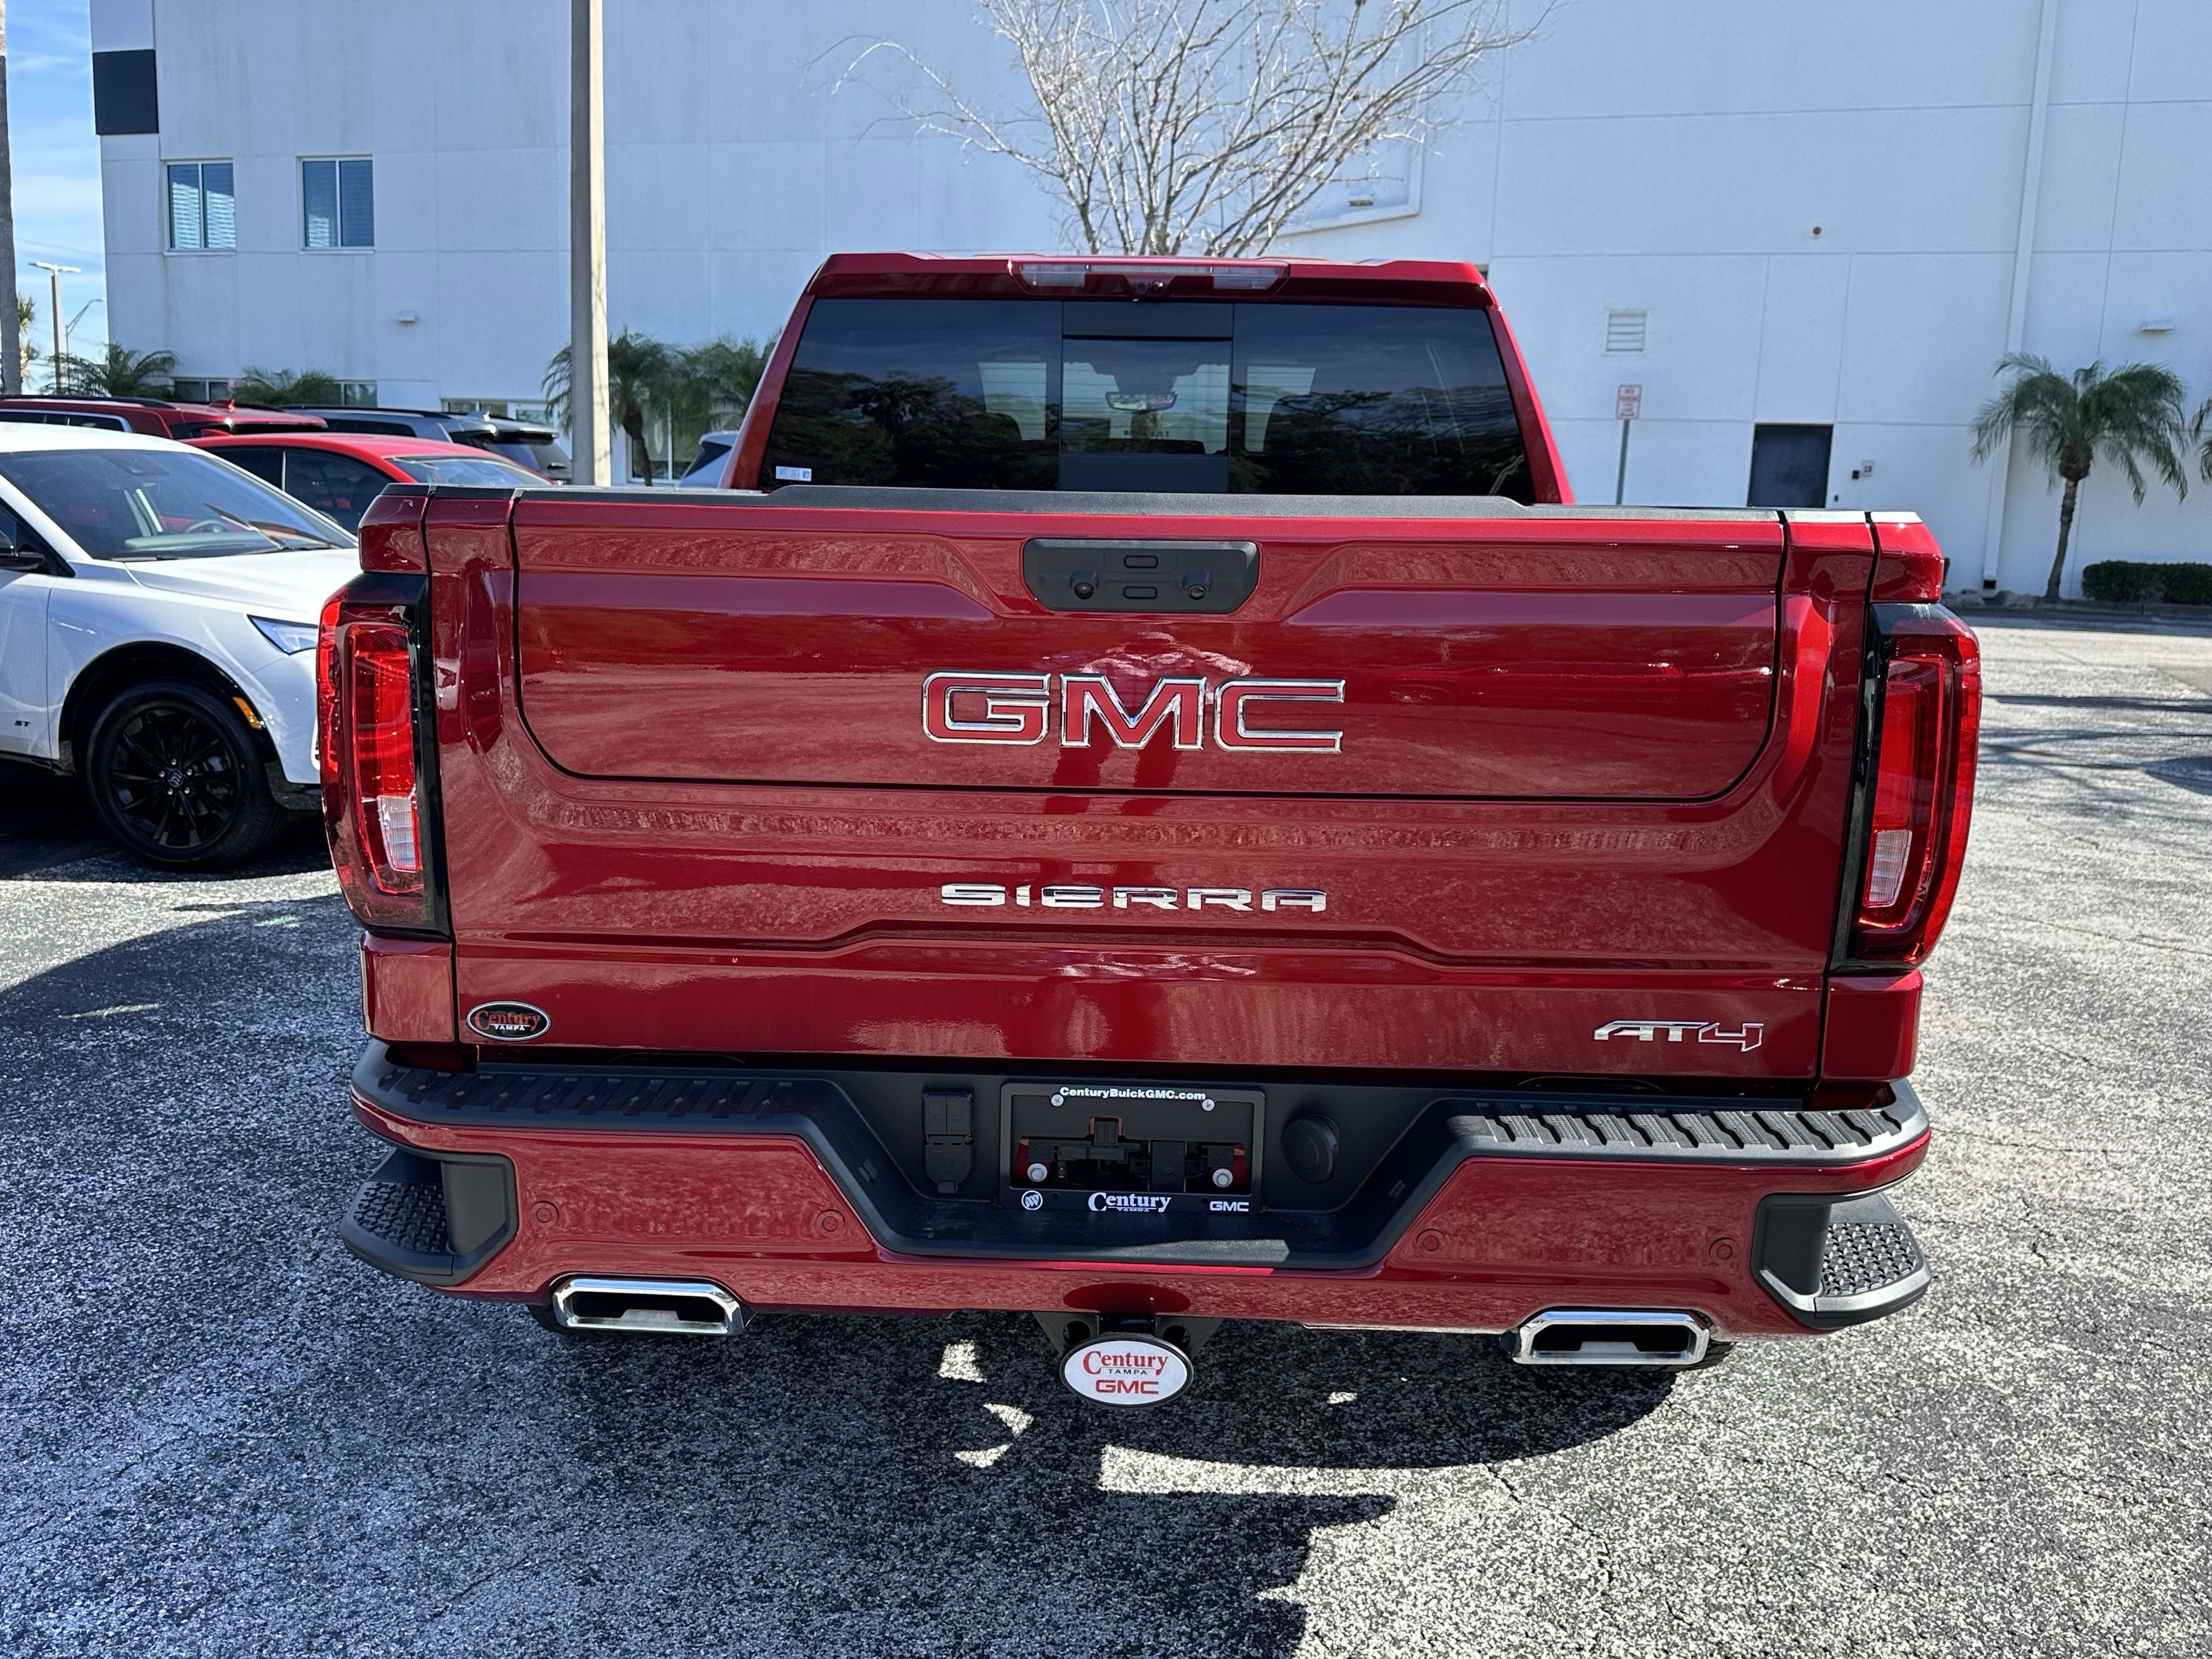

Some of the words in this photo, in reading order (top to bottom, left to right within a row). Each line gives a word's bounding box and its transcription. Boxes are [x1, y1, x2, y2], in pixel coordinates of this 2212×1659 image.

[922, 670, 1346, 754] GMC
[940, 883, 1327, 912] SIERRA
[475, 1010, 541, 1032] Century
[1593, 1020, 1764, 1052] AT4
[1059, 1087, 1206, 1101] CenturyBuickGMC.com
[1088, 1192, 1172, 1213] Century
[1210, 1200, 1250, 1212] GMC
[1083, 1351, 1169, 1376] Century
[1095, 1379, 1159, 1395] GMC
